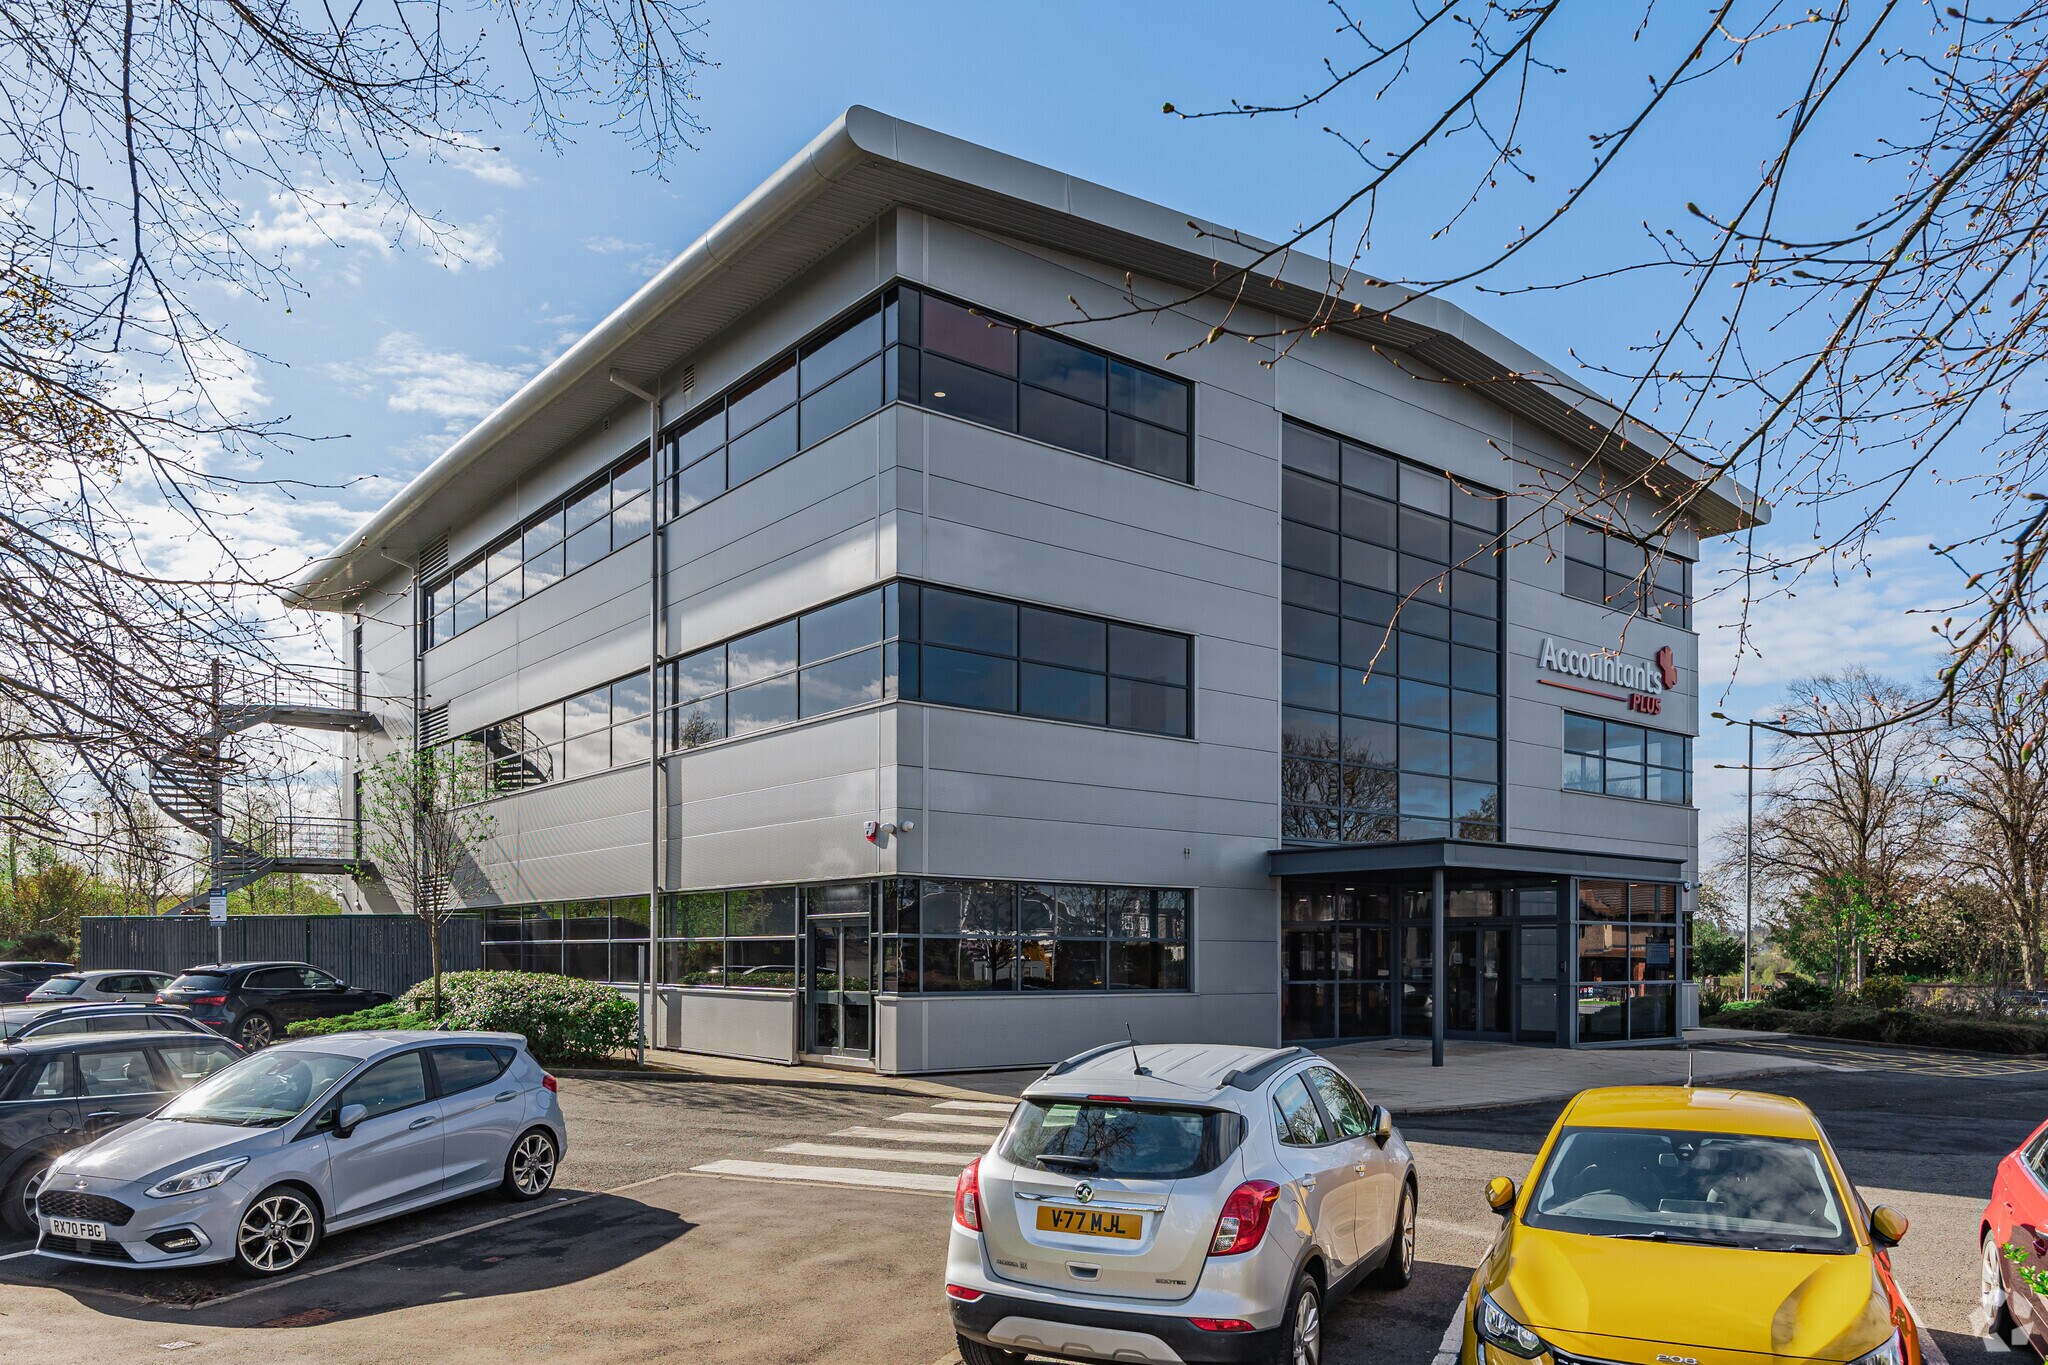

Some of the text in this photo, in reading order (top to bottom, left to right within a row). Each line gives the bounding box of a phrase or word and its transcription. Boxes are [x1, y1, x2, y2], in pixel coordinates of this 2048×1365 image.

[1538, 637, 1663, 695] Accountants
[1630, 692, 1662, 715] PLUS
[53, 1219, 101, 1238] RX70 FBG
[1052, 1209, 1126, 1234] V77 MJL
[1656, 1353, 1698, 1365] 208
